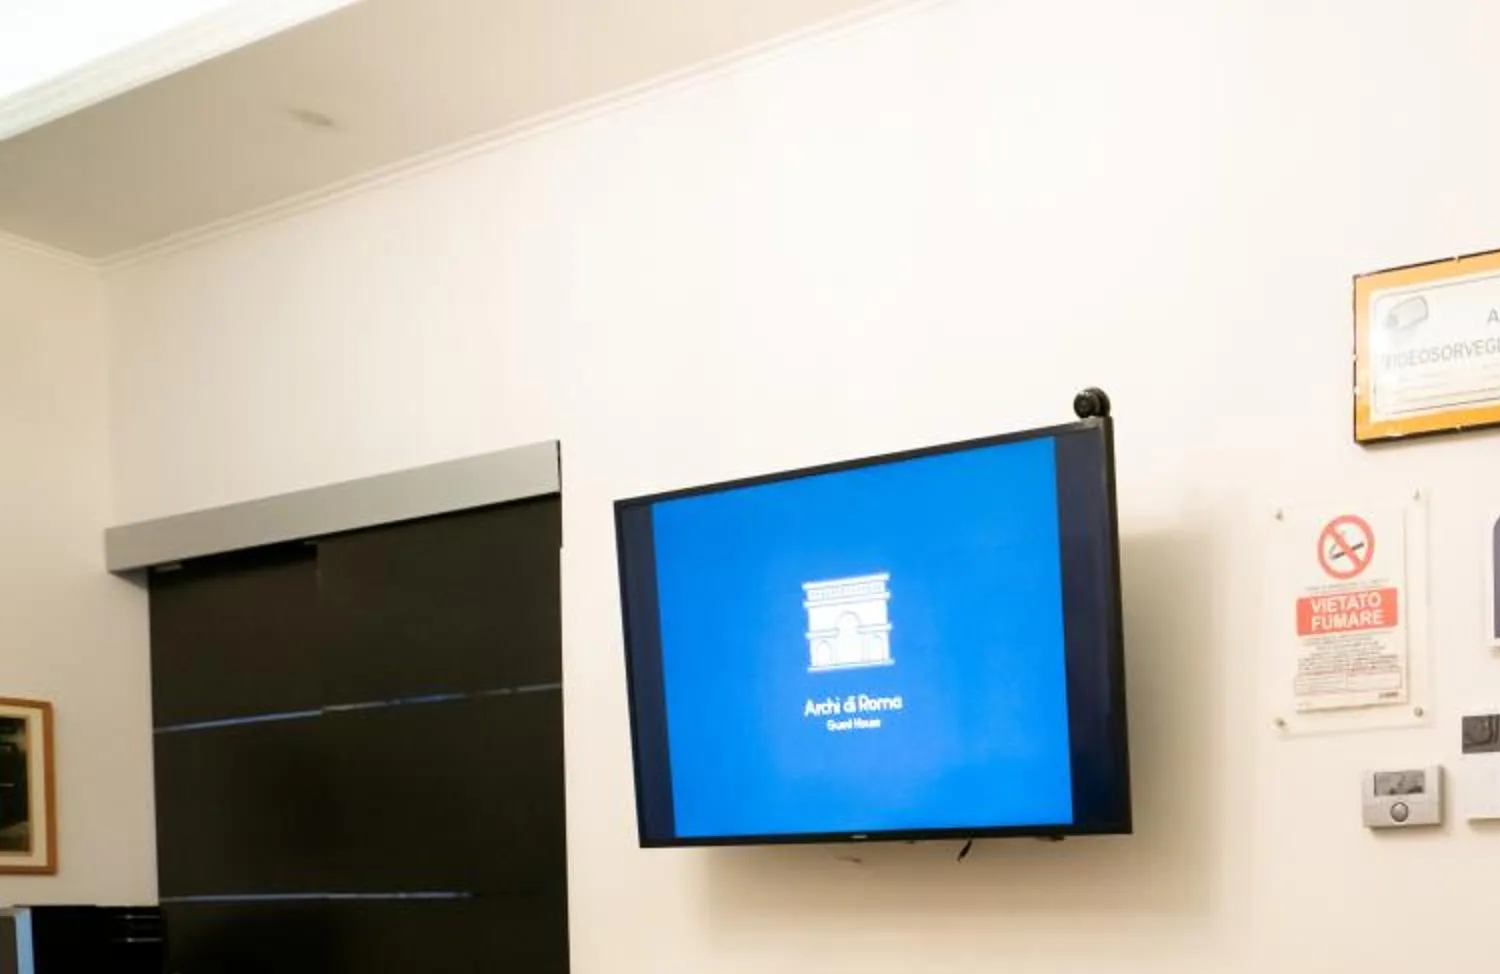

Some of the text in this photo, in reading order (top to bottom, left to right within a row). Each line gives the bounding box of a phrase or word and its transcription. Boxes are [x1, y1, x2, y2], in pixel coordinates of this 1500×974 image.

[1310, 591, 1382, 613] VIETATO
[1311, 609, 1384, 632] FUMARE
[804, 693, 903, 718] Archi di Roma
